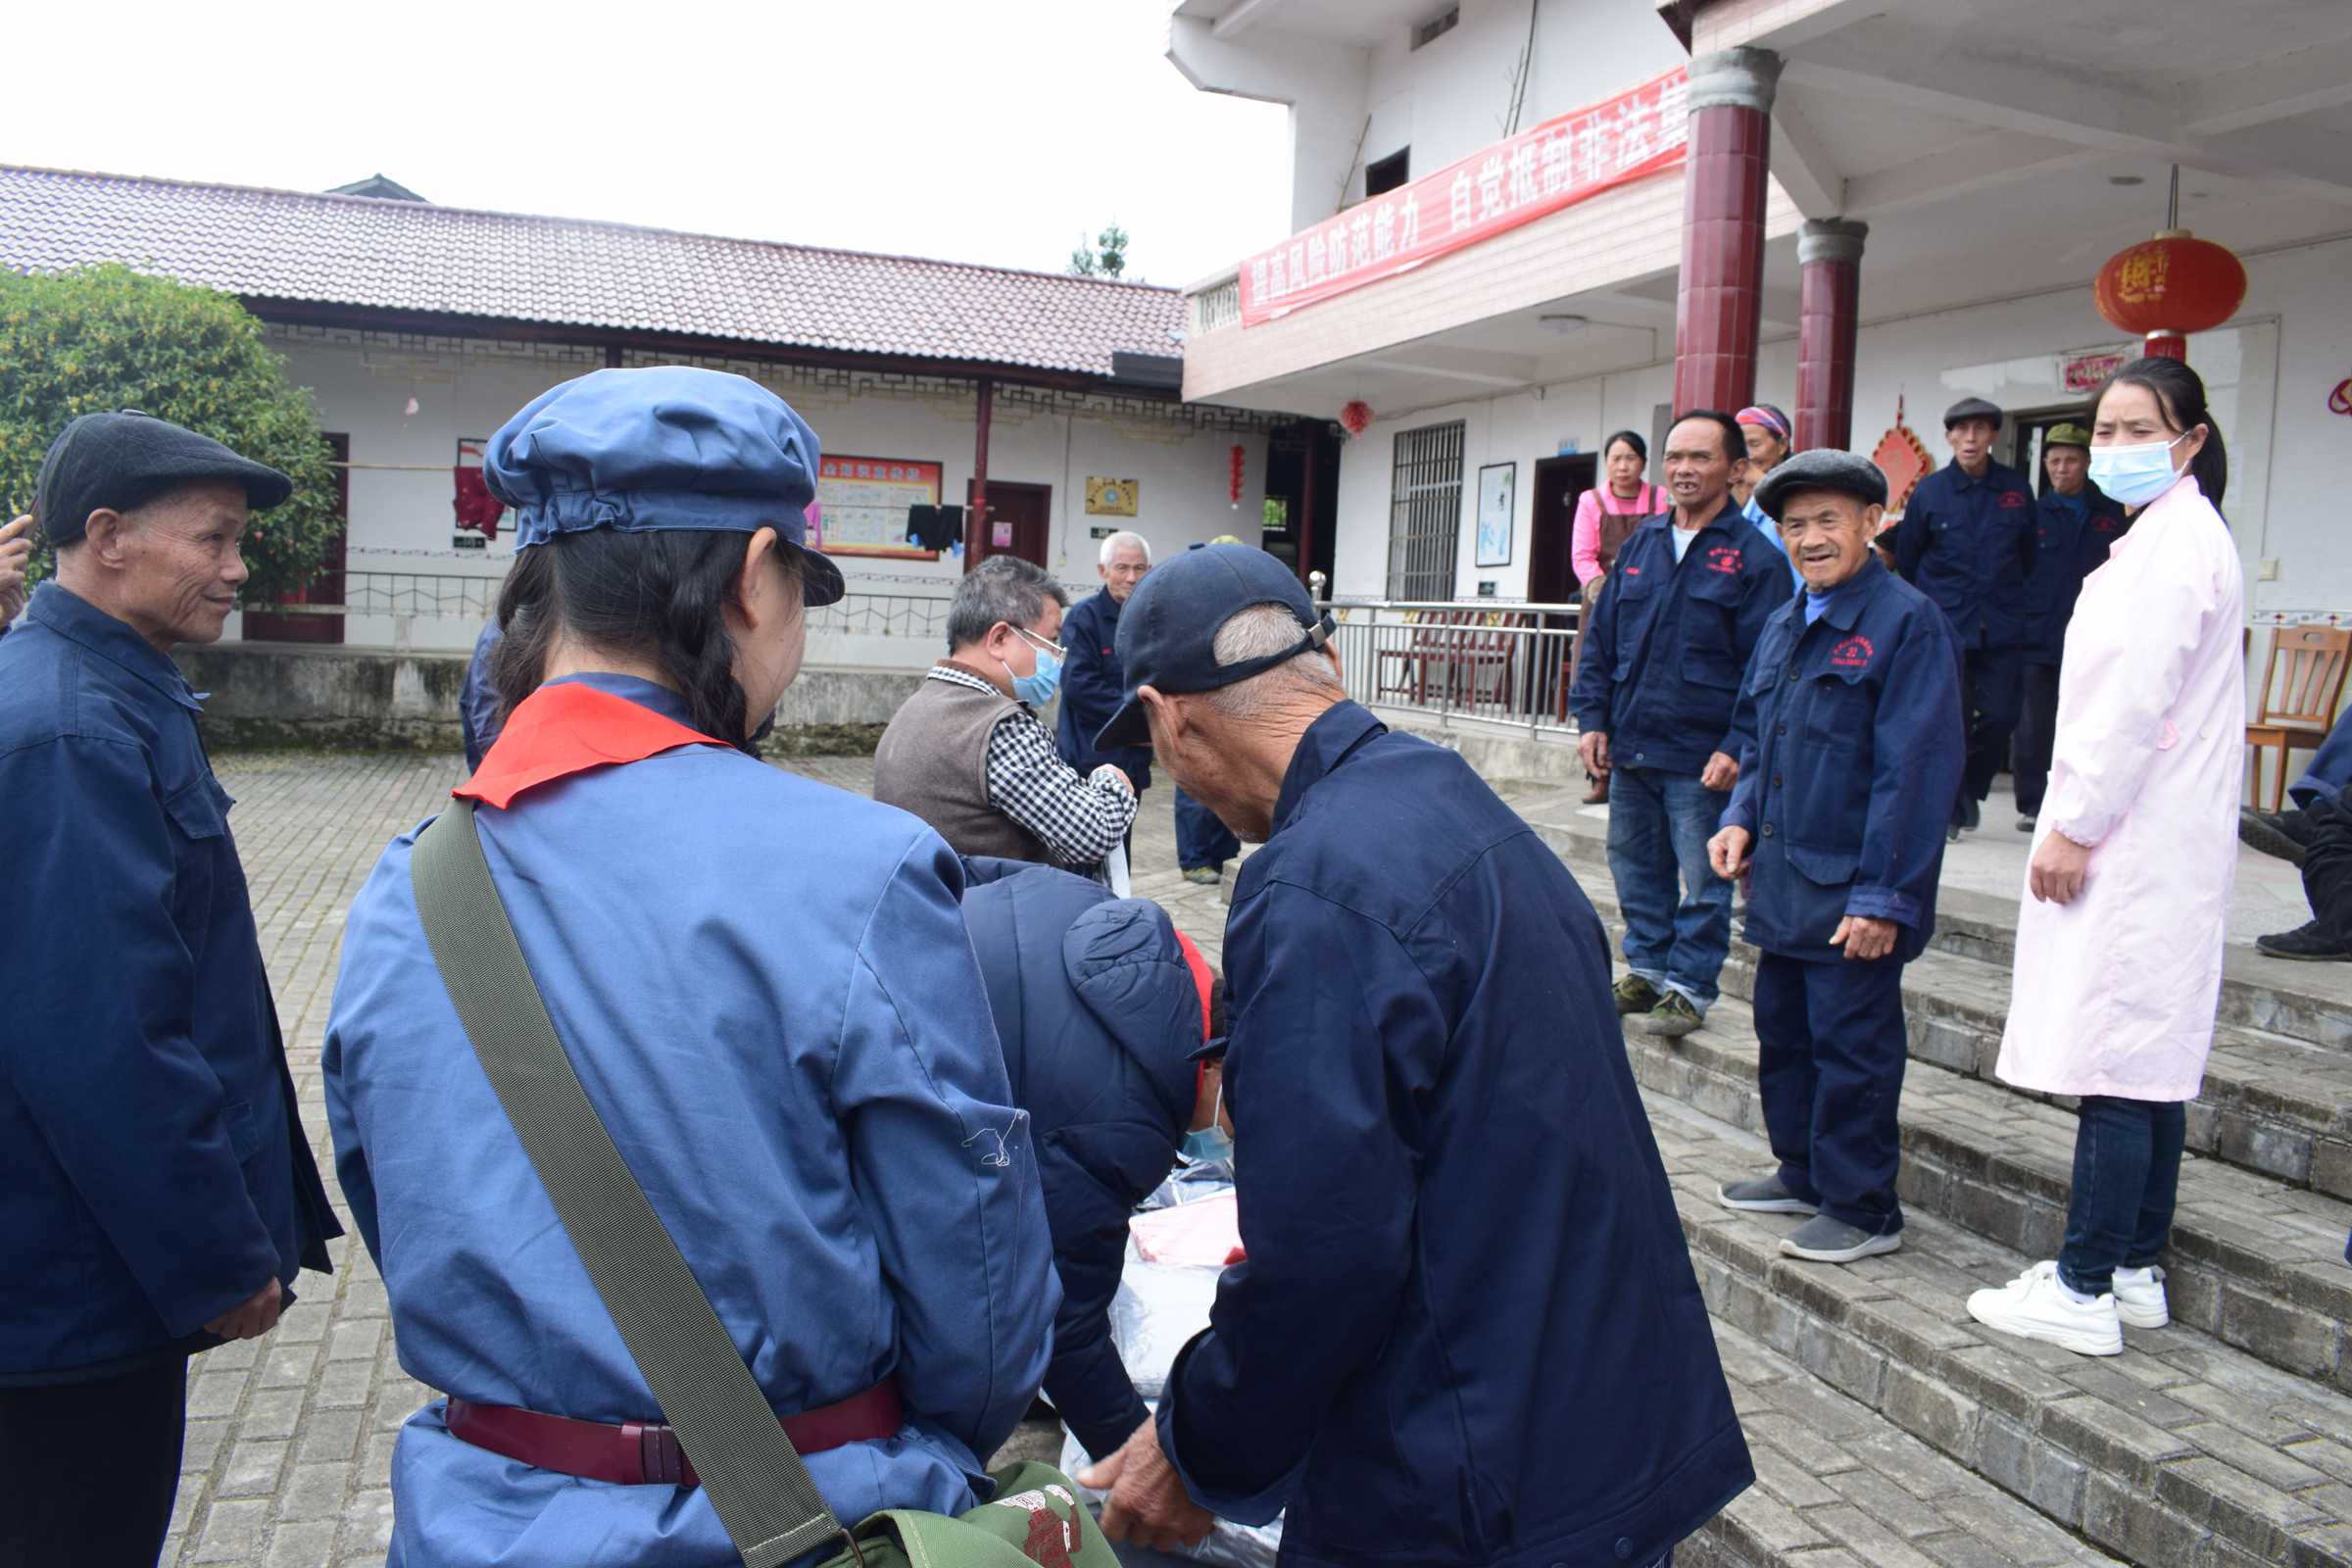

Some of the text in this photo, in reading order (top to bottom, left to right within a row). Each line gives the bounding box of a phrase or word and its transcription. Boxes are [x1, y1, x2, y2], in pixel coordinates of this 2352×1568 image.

[1252, 192, 1419, 306] 提高风险防范能力
